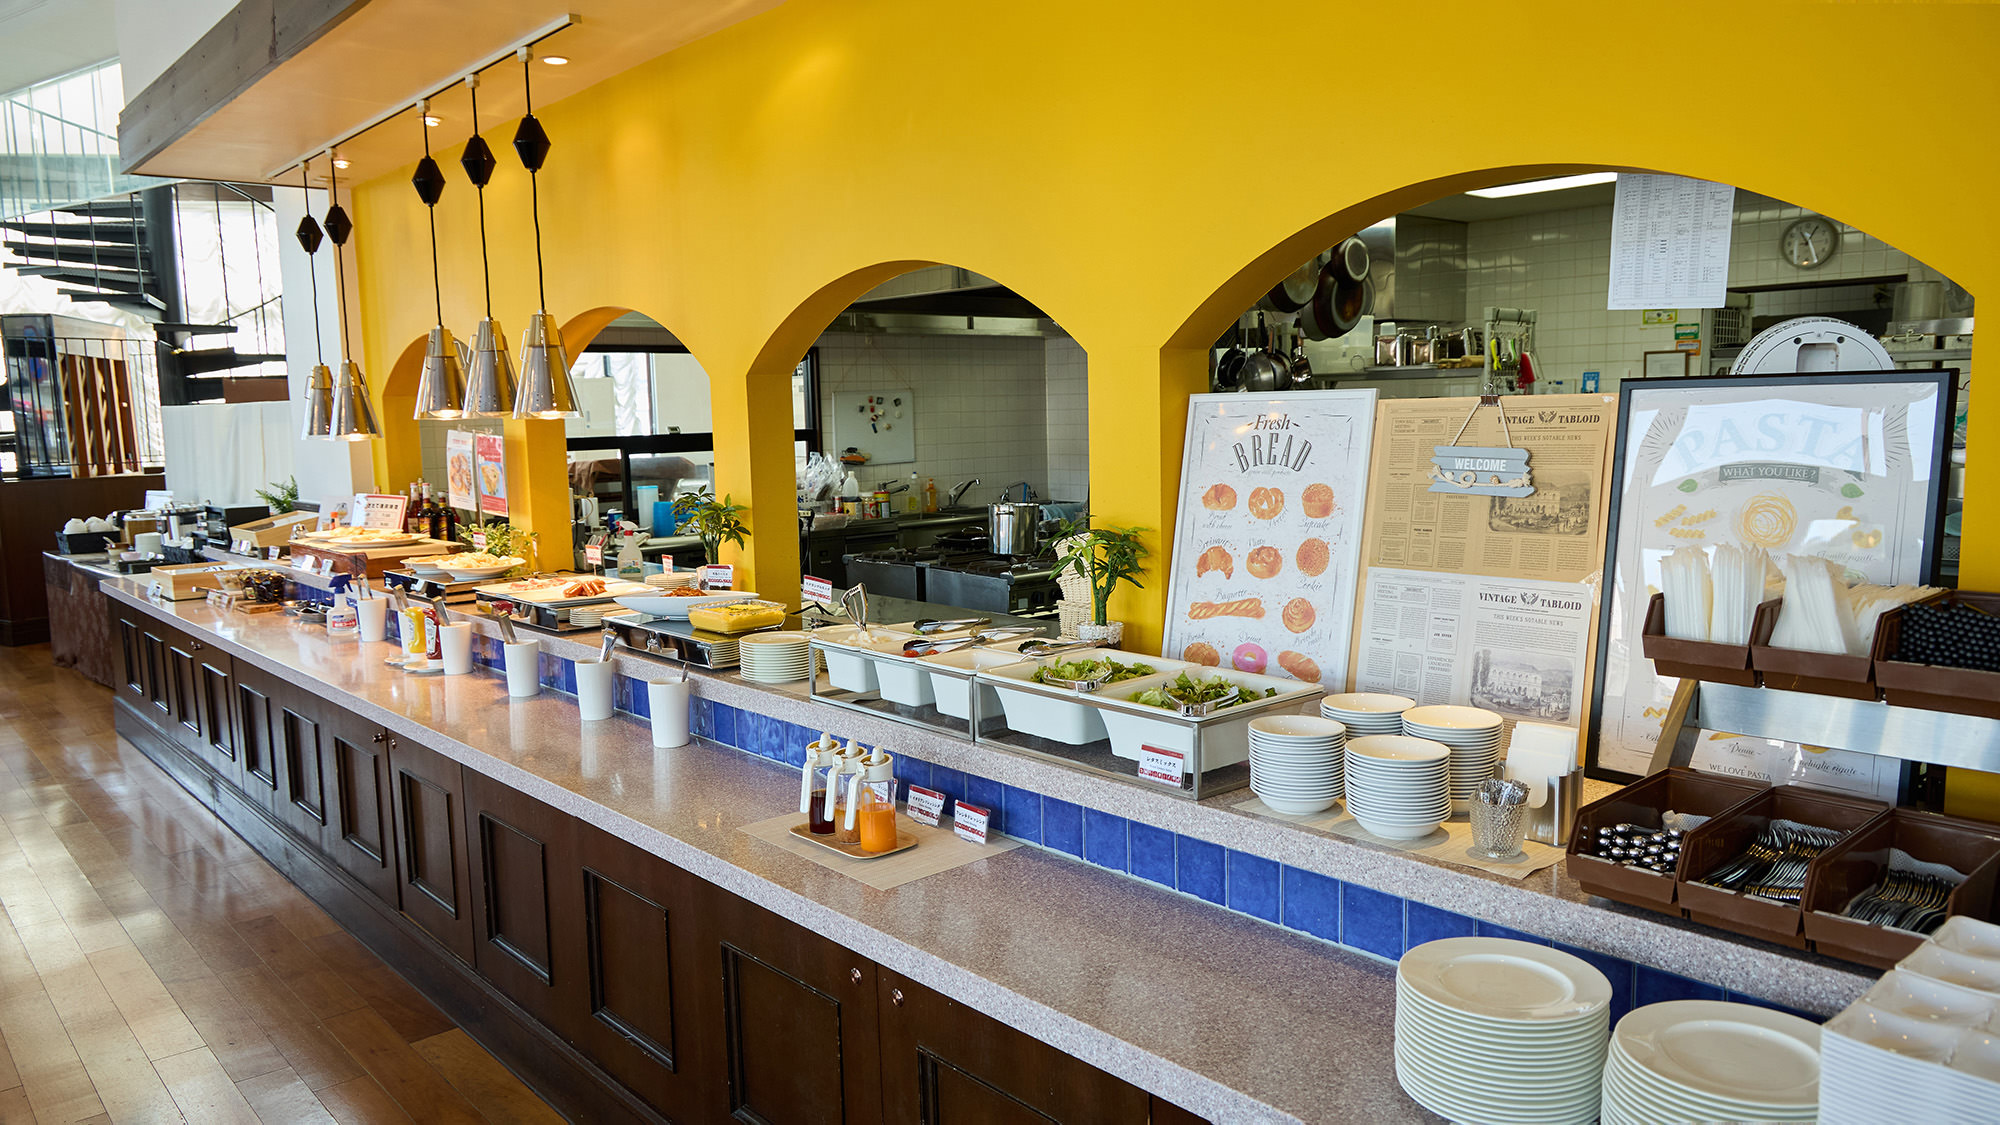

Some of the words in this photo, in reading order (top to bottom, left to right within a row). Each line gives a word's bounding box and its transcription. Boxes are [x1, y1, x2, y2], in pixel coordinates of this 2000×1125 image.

[1253, 413, 1291, 430] Fresh
[1497, 415, 1535, 425] VNTAGE
[1558, 414, 1600, 424] TABLOID
[1232, 432, 1312, 474] BREAD
[1674, 412, 1867, 482] PASTA
[1454, 457, 1507, 472] WELCOME
[1723, 466, 1755, 477] WHAT
[1758, 467, 1781, 477] YOU
[1479, 592, 1517, 604] VINTAGE
[1540, 598, 1582, 611] TABLOID
[1709, 763, 1721, 771] WE
[1723, 766, 1745, 776] LOVE
[1747, 770, 1772, 782] PASTA
